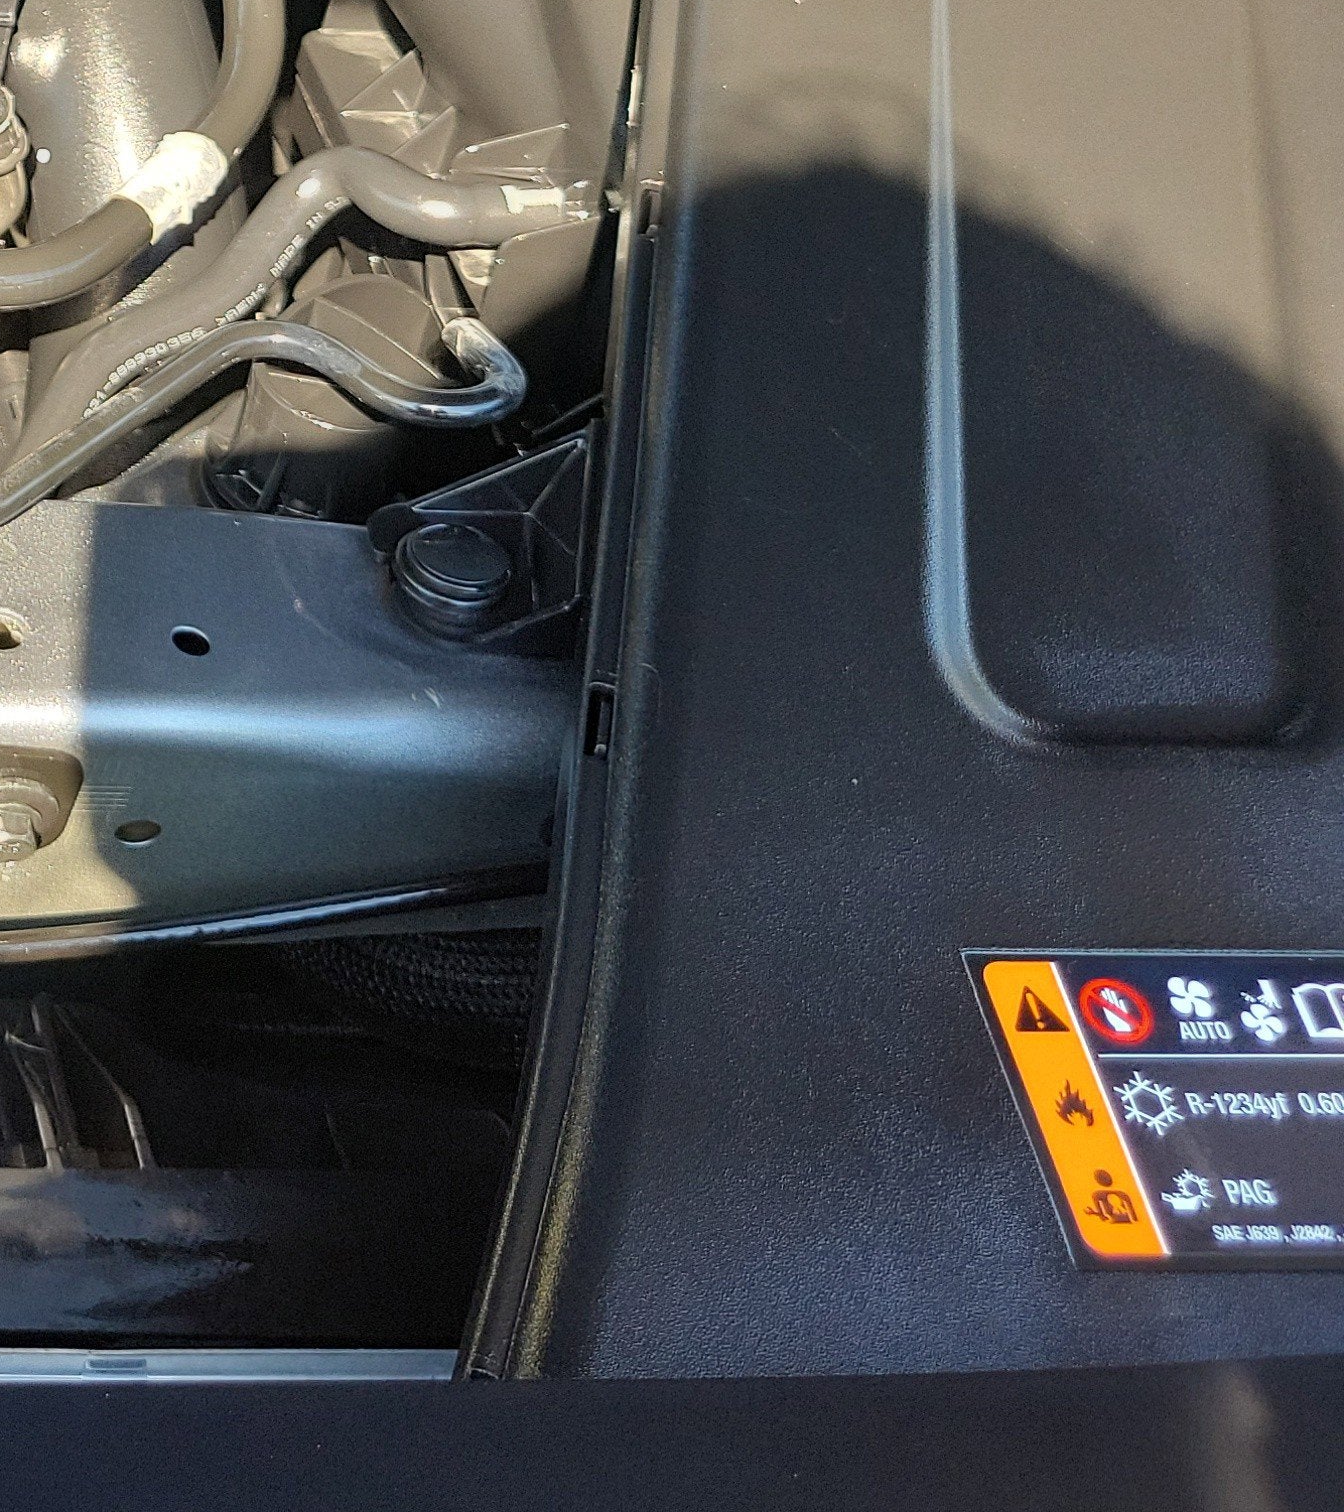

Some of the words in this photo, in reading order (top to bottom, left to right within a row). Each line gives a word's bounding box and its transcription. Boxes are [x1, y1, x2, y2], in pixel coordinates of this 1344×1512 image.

[1178, 1020, 1232, 1040] AUTO
[1184, 1092, 1291, 1121] R-1234yf
[1221, 1178, 1279, 1205] PAG
[1212, 1224, 1246, 1241] SAE
